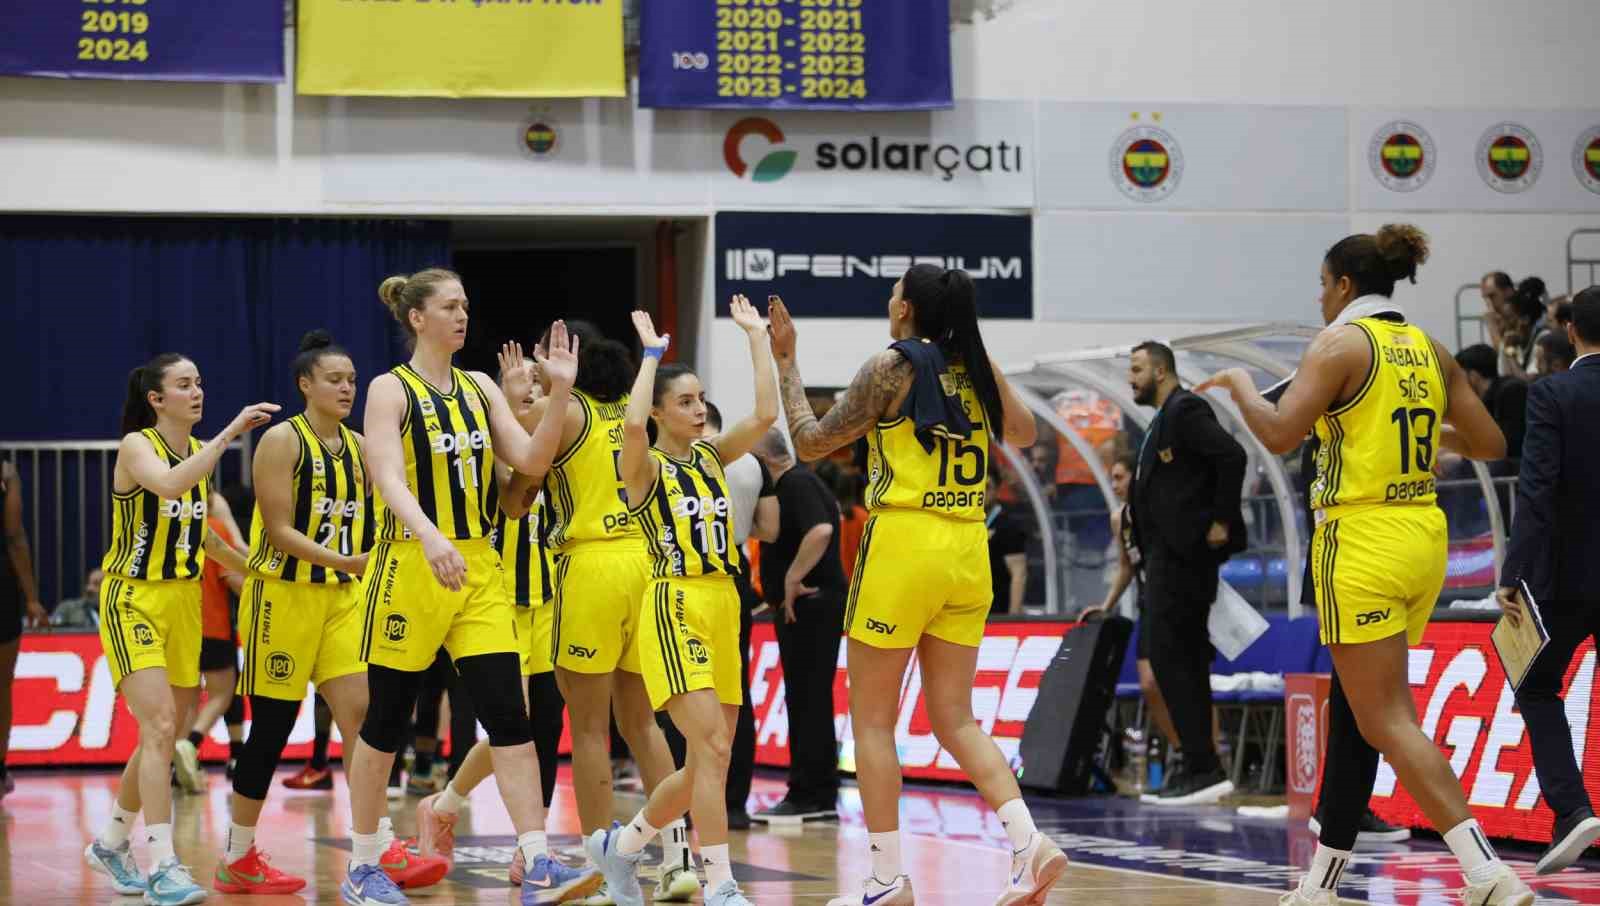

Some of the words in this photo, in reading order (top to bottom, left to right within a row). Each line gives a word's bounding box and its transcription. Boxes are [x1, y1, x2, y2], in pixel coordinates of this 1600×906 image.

[82, 10, 149, 33] 2019
[717, 8, 783, 29] 2020
[801, 10, 862, 30] 2021
[78, 37, 149, 61] 2024
[717, 31, 778, 51] 2021
[802, 32, 865, 53] 2022
[718, 53, 783, 74] 2022
[802, 54, 865, 76] 2023
[718, 76, 781, 97] 2023
[801, 78, 866, 99] 2024
[816, 137, 1023, 181] solarçatı
[1383, 345, 1430, 368] SABALY
[1392, 407, 1436, 474] 13
[938, 424, 985, 487] 15
[453, 456, 479, 489] 11
[922, 491, 985, 512] papara
[175, 525, 191, 556] 4
[319, 522, 350, 555] 21
[695, 520, 726, 554] 10
[866, 619, 898, 634] DSV
[1356, 608, 1391, 626] DSV
[568, 645, 597, 659] DSV
